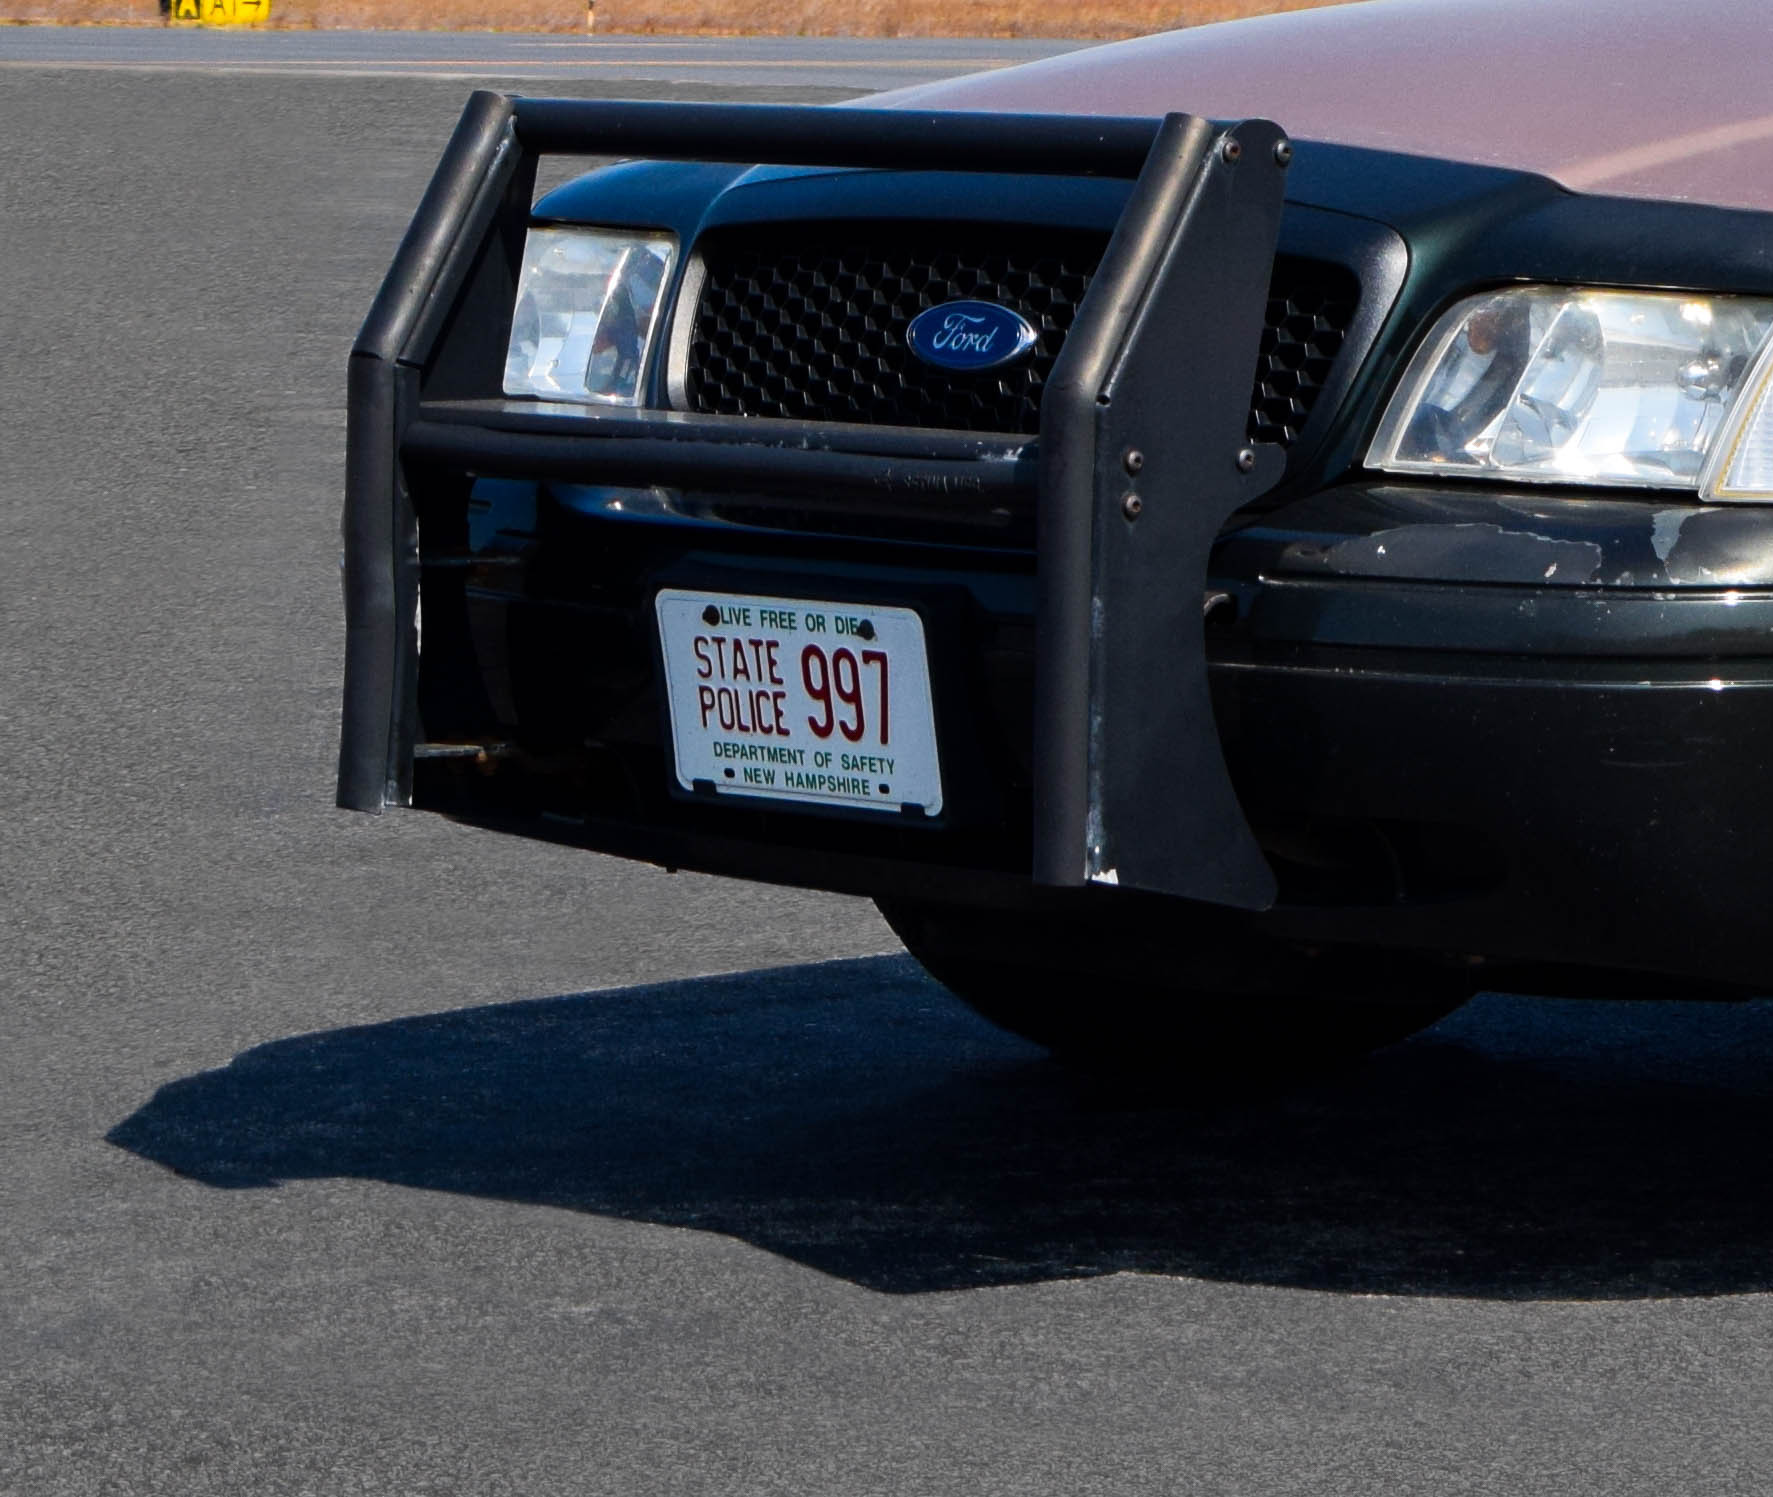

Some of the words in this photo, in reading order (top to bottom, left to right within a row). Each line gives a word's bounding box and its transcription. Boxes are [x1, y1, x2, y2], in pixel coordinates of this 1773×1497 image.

[933, 312, 999, 352] Ford
[720, 606, 752, 626] LIVE
[760, 610, 797, 630] FREE
[805, 613, 826, 633] OR
[835, 616, 858, 635] DIE
[694, 635, 784, 685] STATE
[698, 684, 791, 736] POLICE
[800, 643, 889, 745] 997
[713, 741, 805, 767] DEPARTMENT
[814, 752, 832, 769] OF
[841, 754, 895, 775] SAFETY
[743, 766, 776, 784] NEW
[785, 771, 871, 796] HAMPSHIRE
